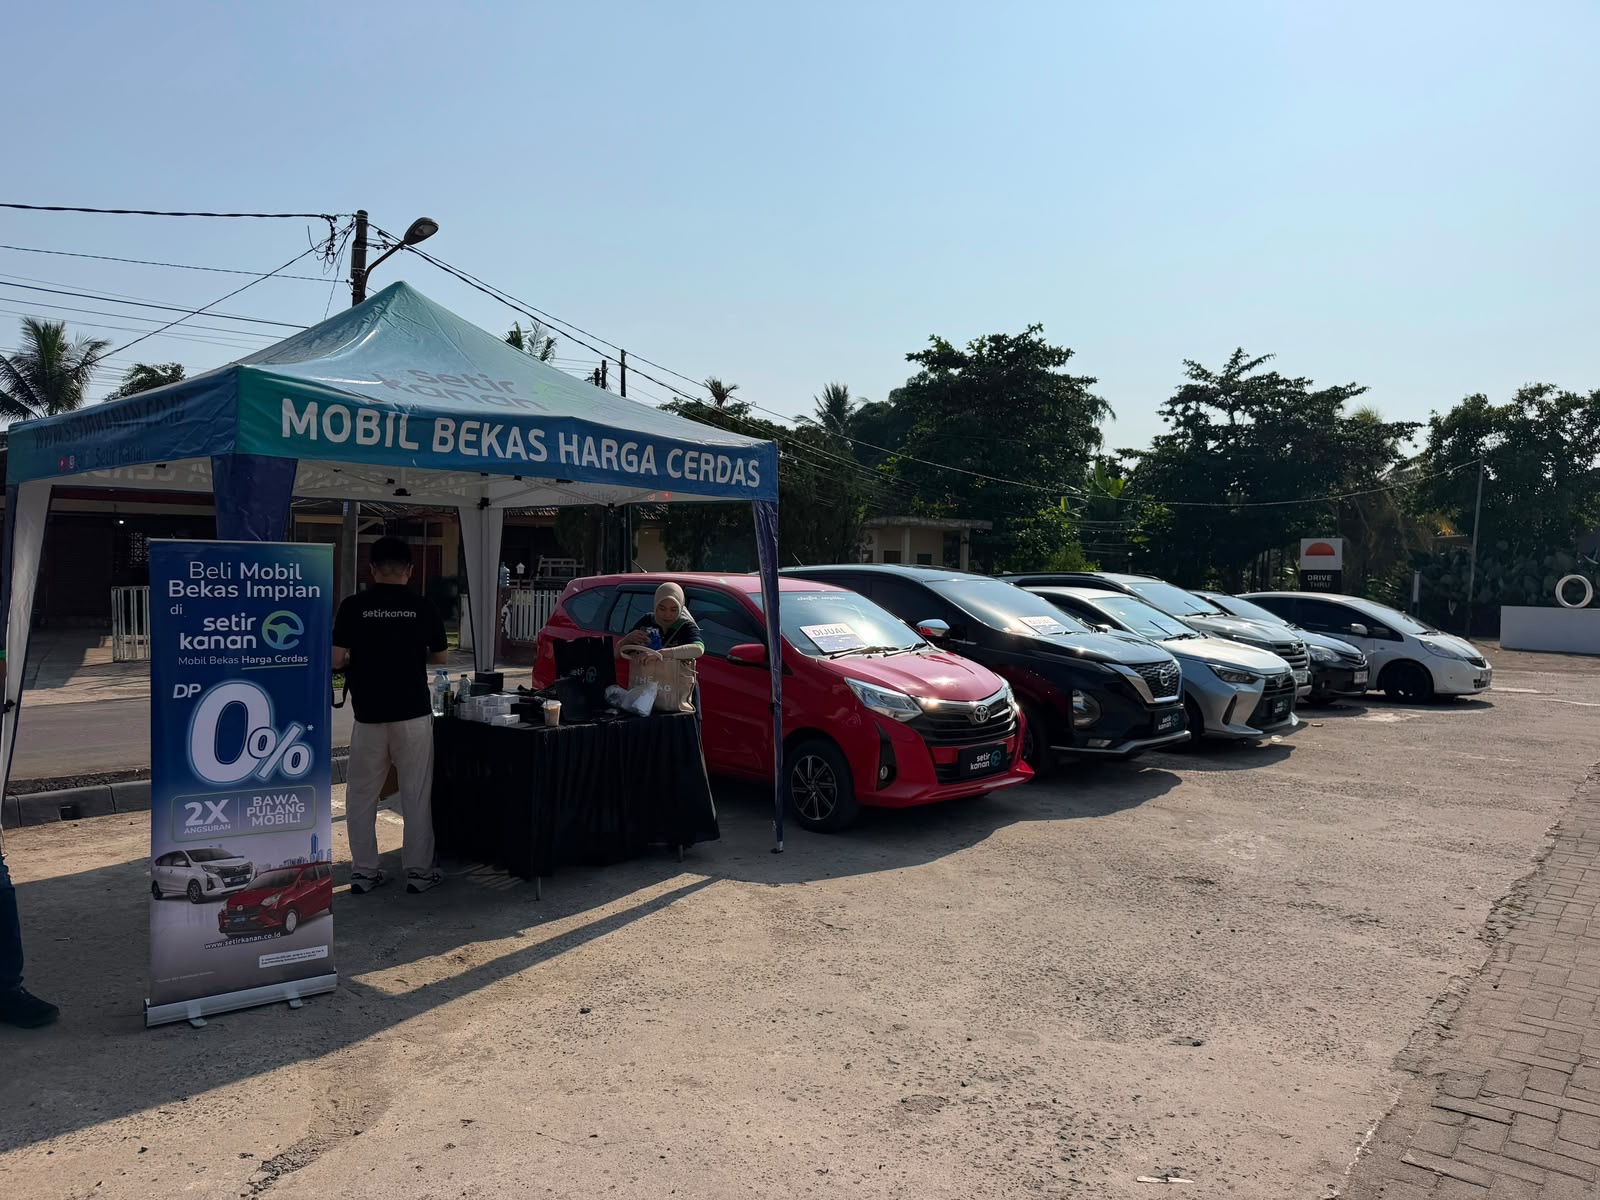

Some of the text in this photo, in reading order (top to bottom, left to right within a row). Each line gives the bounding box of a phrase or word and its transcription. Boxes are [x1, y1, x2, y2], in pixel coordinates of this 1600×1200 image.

[407, 369, 517, 394] setir
[281, 398, 760, 488] MOBIL BEKAS HARGA CERDAS
[189, 561, 302, 580] Beli Mobil
[168, 579, 321, 602] Bekas Impian
[170, 603, 183, 615] di
[362, 608, 417, 618] setirkanan
[203, 612, 256, 632] setir
[812, 627, 847, 637] DIJUAL
[180, 632, 257, 650] kanan
[178, 654, 309, 666] Mobil Bekas Harga Cerdas
[172, 683, 201, 699] DP
[976, 752, 990, 762] setir
[252, 793, 300, 807] BAWA
[184, 799, 230, 827] 2X
[246, 802, 305, 817] PULANG
[251, 812, 301, 827] MOBIL!
[184, 823, 231, 834] ANGSURAN
[205, 932, 281, 949] www.setirkanan.co.id
